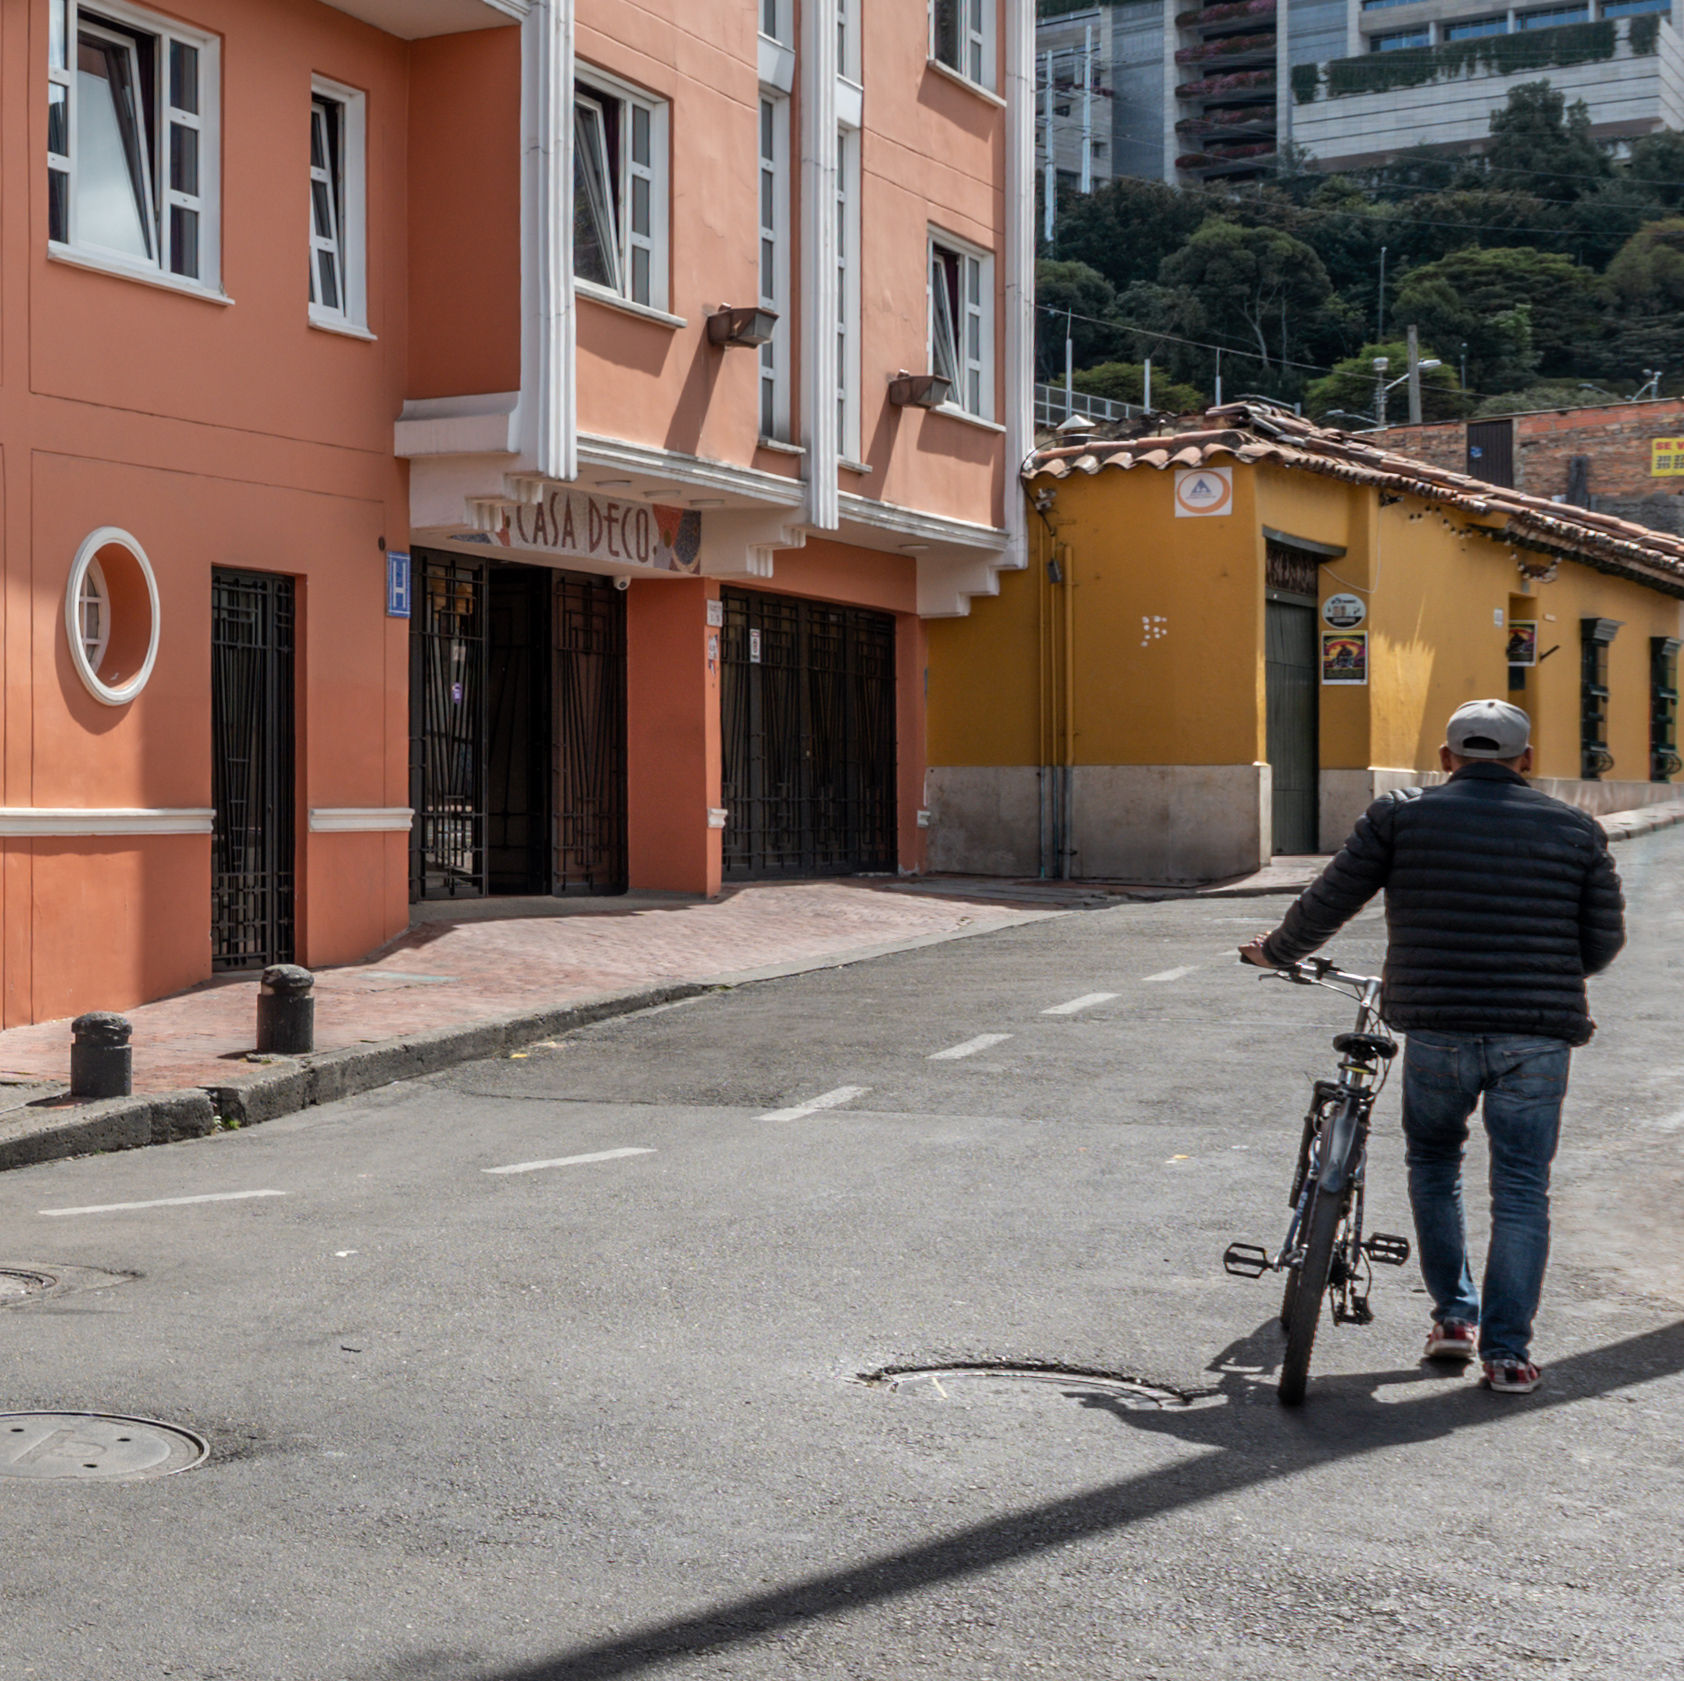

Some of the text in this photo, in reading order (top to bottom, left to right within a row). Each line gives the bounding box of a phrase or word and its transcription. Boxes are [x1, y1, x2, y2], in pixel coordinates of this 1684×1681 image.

[516, 491, 650, 563] CASA DECO
[392, 560, 406, 609] H
